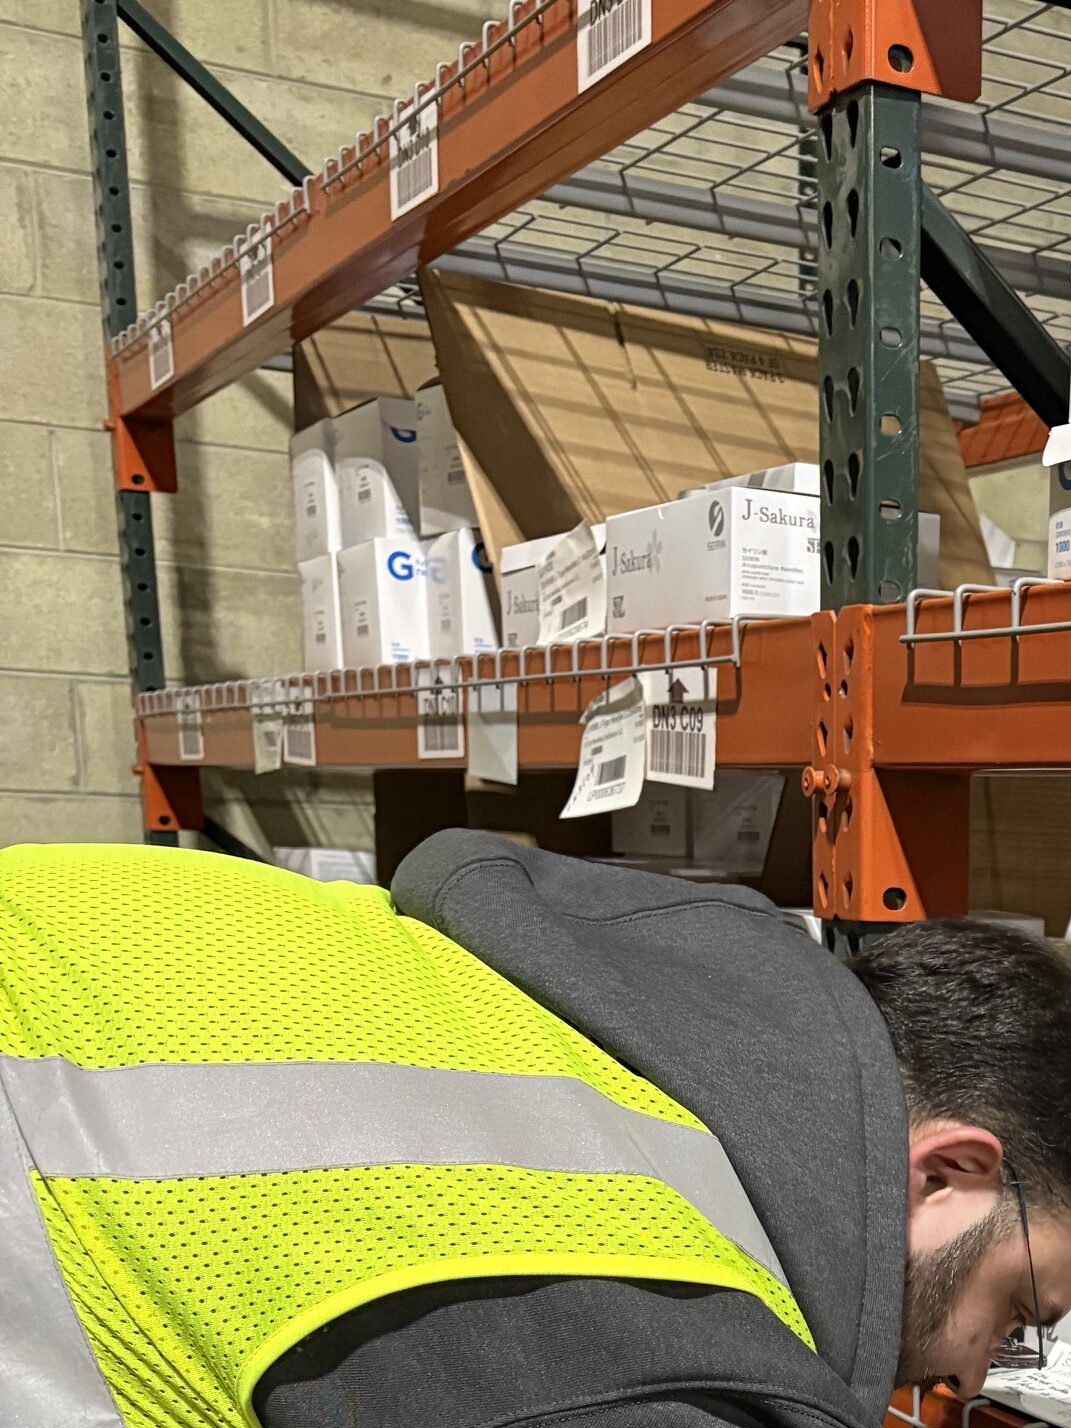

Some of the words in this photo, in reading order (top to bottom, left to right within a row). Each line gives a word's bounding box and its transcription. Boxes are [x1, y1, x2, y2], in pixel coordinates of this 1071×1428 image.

[742, 499, 815, 529] J-Sakura
[387, 551, 414, 581] G
[653, 704, 677, 731] DN3
[680, 706, 705, 732] C09
